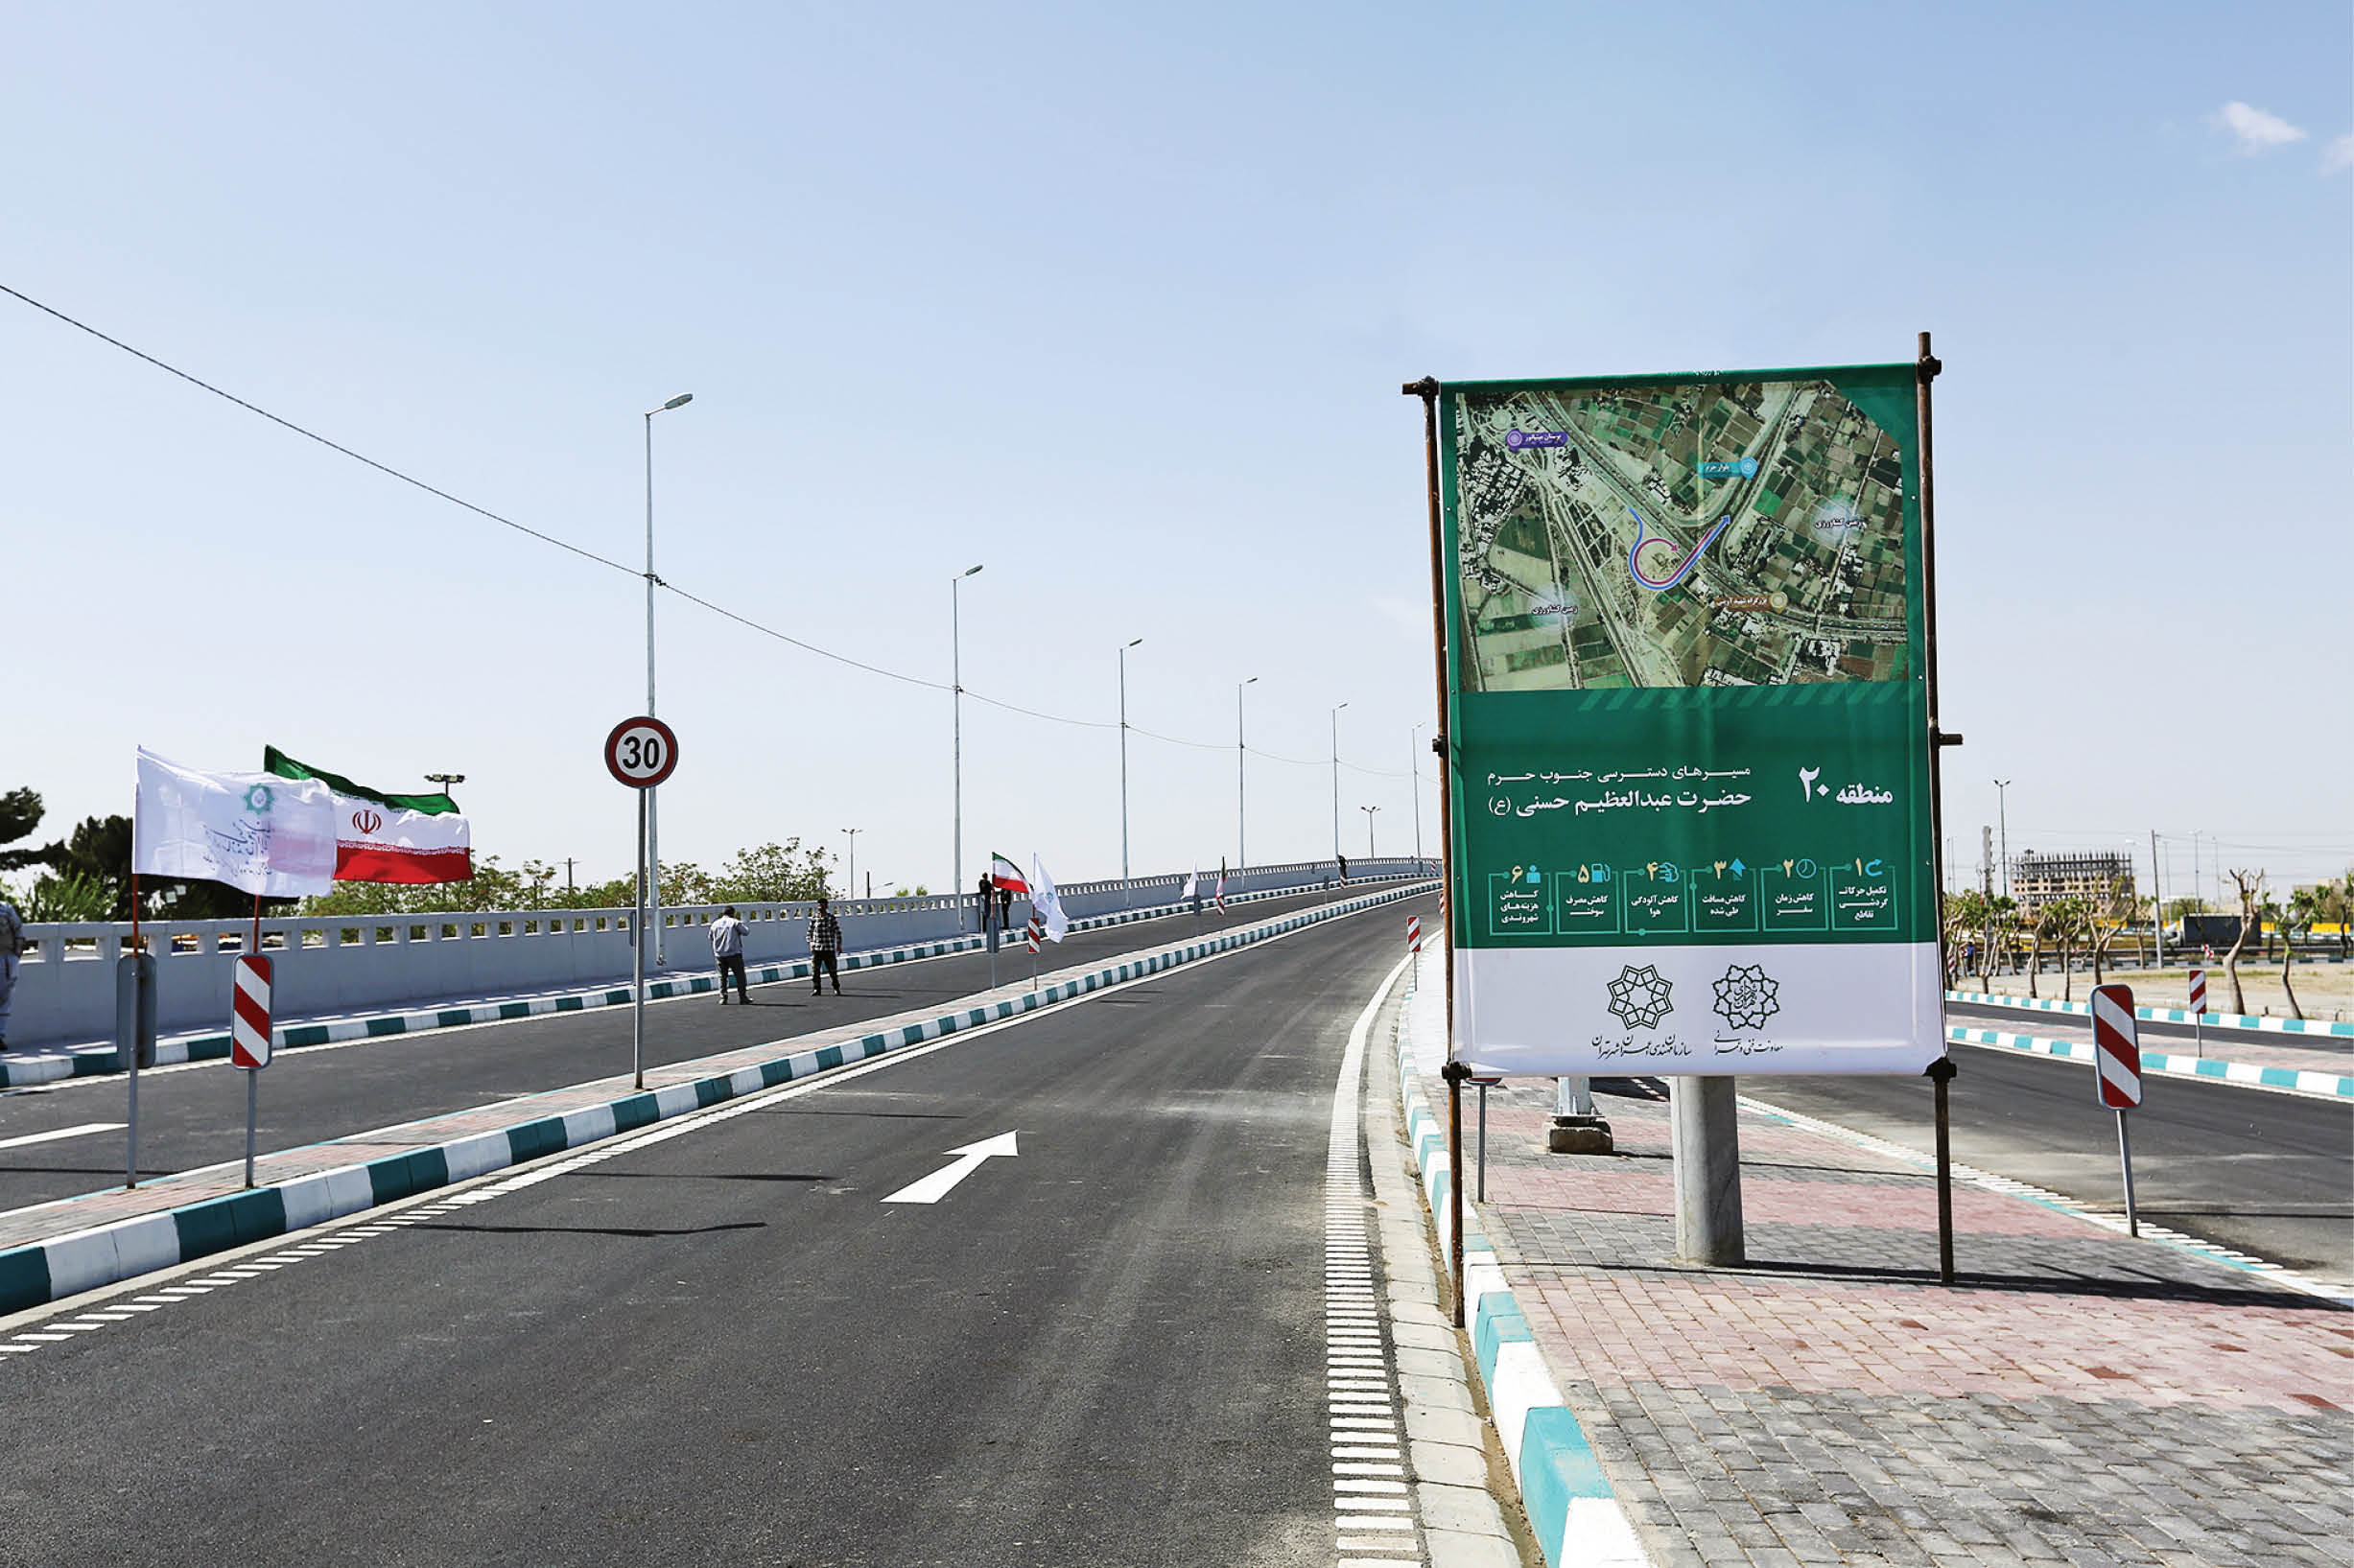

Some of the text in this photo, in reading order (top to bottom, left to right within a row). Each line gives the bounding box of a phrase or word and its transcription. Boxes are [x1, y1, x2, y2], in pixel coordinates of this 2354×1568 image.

[623, 736, 660, 769] 30
[1488, 765, 1752, 786] مسیرهای دسترسی جنوب حرم
[1799, 766, 1894, 804] منطقه ۲۰
[1488, 789, 1753, 817] حضرت عبدالعظیم حسنی (ع)
[1646, 861, 1659, 882] ۴
[1713, 860, 1727, 880] ۳
[1782, 858, 1794, 879] ۲
[1855, 856, 1863, 877] ۱
[1511, 865, 1523, 884] ۶
[1577, 863, 1589, 883] ۵
[1499, 890, 1540, 901] کاهش
[1838, 885, 1887, 897] تکمیل حرکات
[1565, 895, 1609, 907] کاهش مصرف
[1631, 894, 1680, 906] کاهش آلودگی
[1702, 894, 1747, 905] کاهش مسافت
[1775, 893, 1815, 904] کاهش زمان
[1838, 898, 1889, 909] گردشی
[1569, 906, 1605, 918] سوخت
[1650, 907, 1661, 919] هوا
[1725, 906, 1739, 918] طی
[1776, 904, 1813, 916] سفر
[1500, 912, 1540, 924] شهروندی
